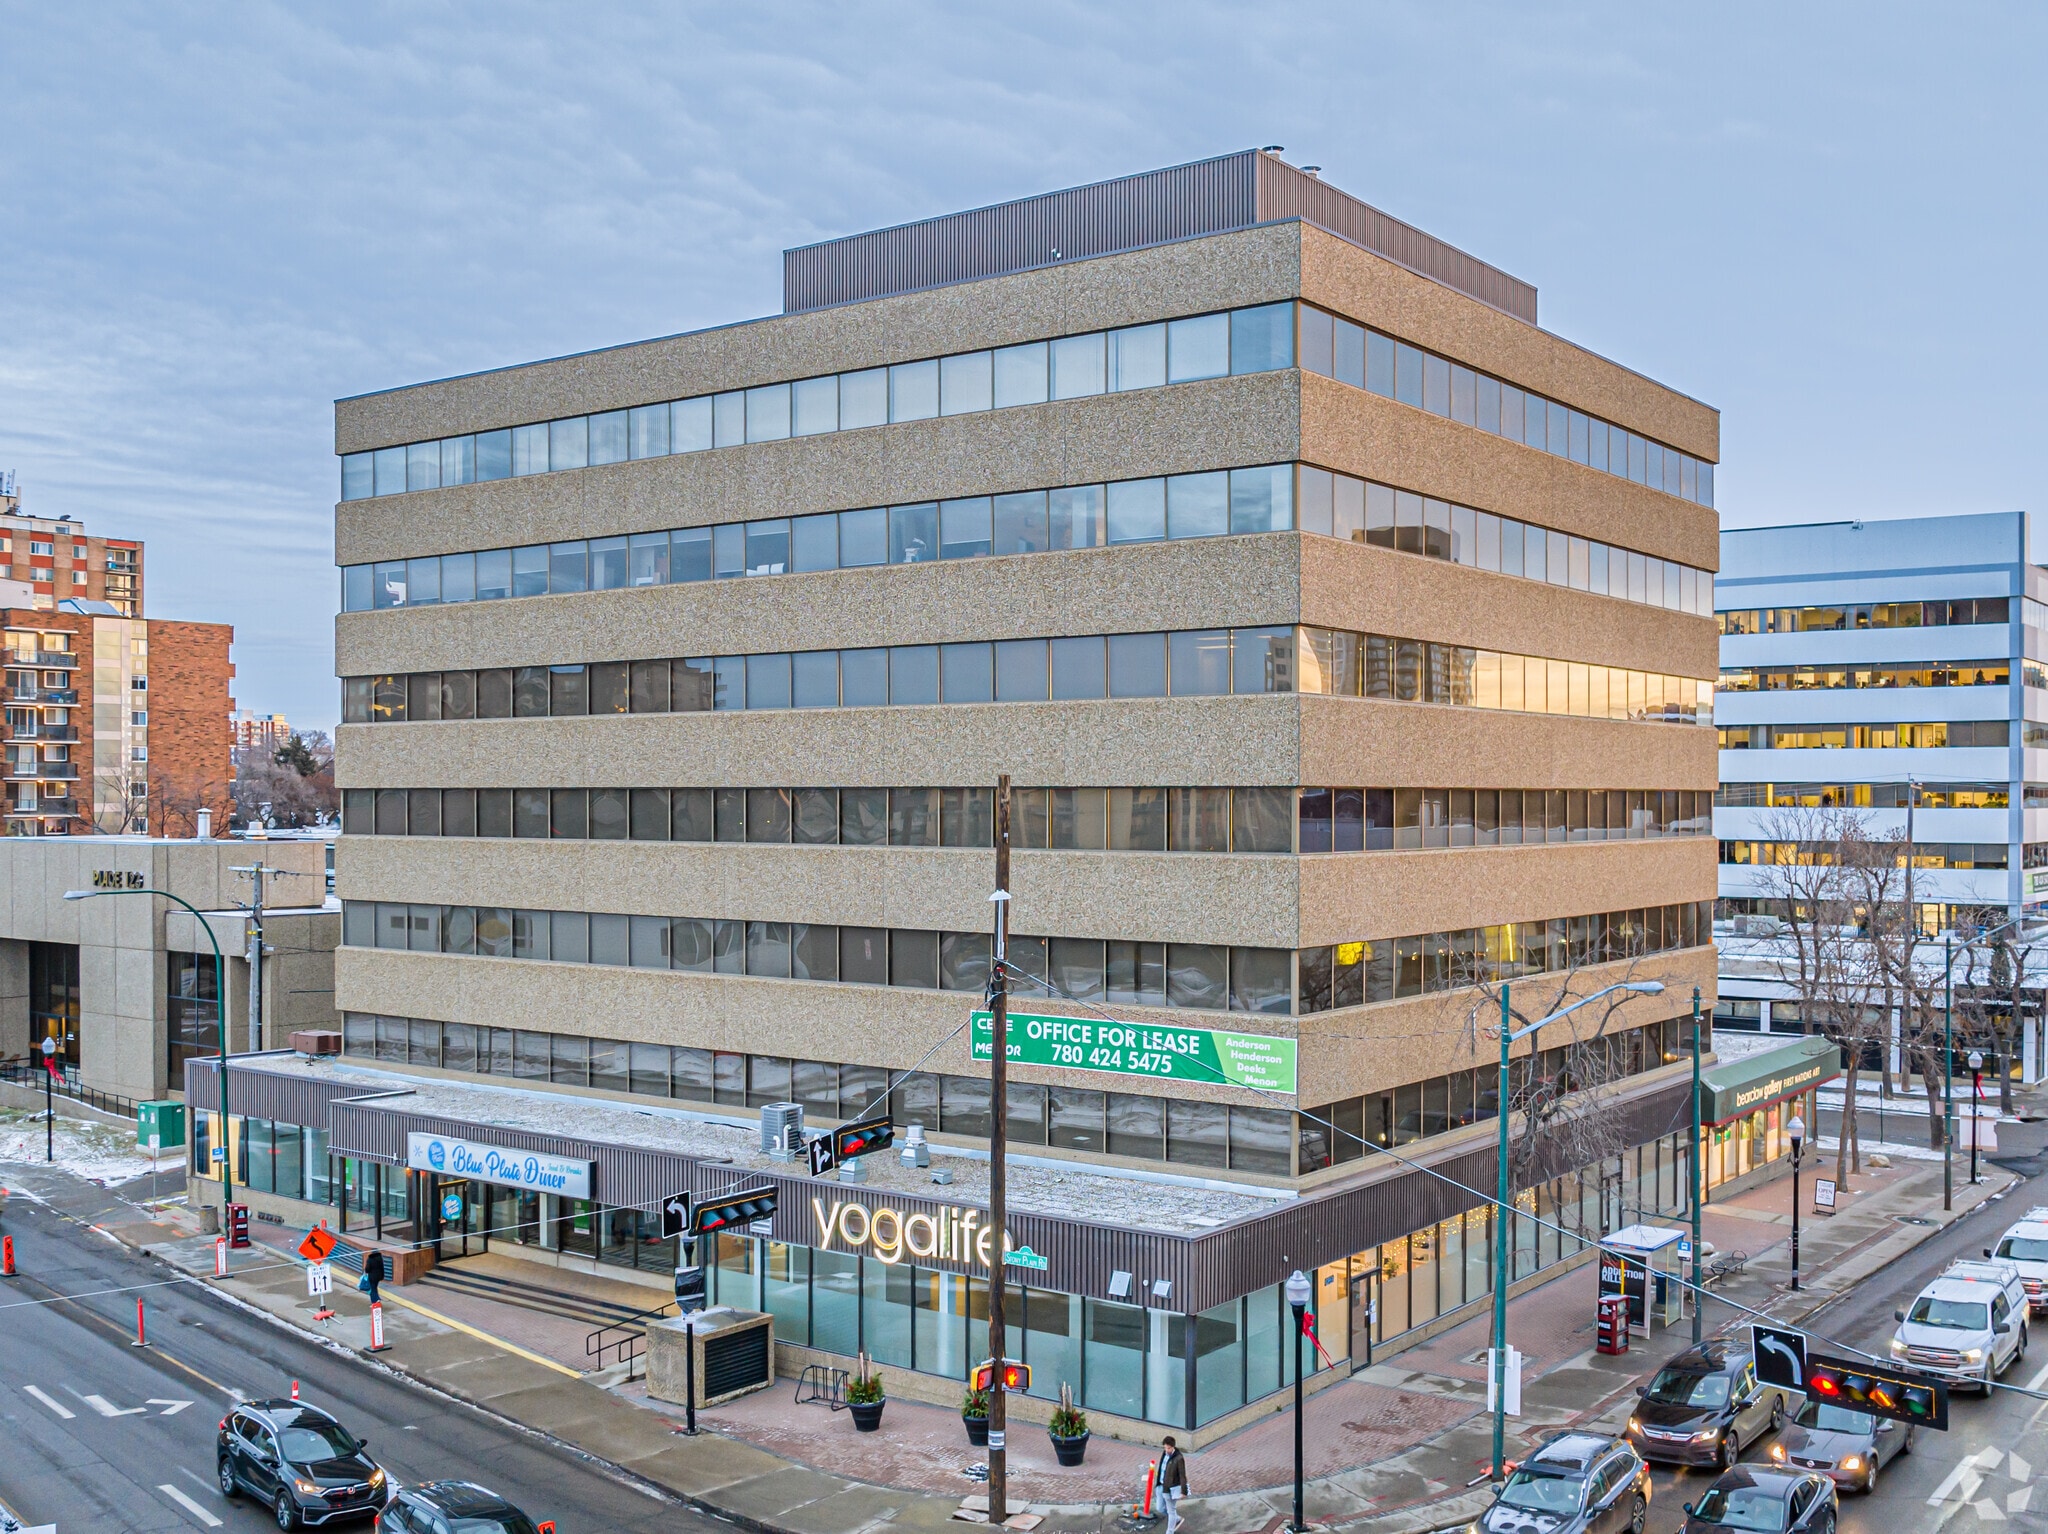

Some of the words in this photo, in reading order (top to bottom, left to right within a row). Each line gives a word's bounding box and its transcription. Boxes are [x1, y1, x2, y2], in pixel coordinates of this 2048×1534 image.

[93, 870, 122, 888] PLACE
[977, 1018, 1014, 1032] CBE
[1026, 1020, 1092, 1044] OFFICE
[1098, 1027, 1137, 1048] FOR
[1143, 1030, 1200, 1055] LEASE
[1225, 1037, 1271, 1051] Anderson
[975, 1042, 1022, 1057] MEOR
[1230, 1049, 1282, 1065] Henderson
[1051, 1044, 1083, 1064] 780
[1088, 1047, 1121, 1068] 424
[1127, 1051, 1172, 1074] 5475
[1236, 1062, 1266, 1075] Deeks
[1244, 1074, 1278, 1087] Menon
[1736, 1086, 1764, 1107] bearclaw
[1763, 1079, 1783, 1100] gallery
[1783, 1076, 1795, 1088] FIRST
[1795, 1069, 1812, 1084] NATIONS
[1812, 1066, 1821, 1078] ART
[451, 1145, 484, 1173] Blue
[485, 1150, 521, 1178] Plate
[524, 1157, 566, 1189] Diner
[812, 1198, 1014, 1267] yogalife
[1602, 1266, 1644, 1280] ADDITION
